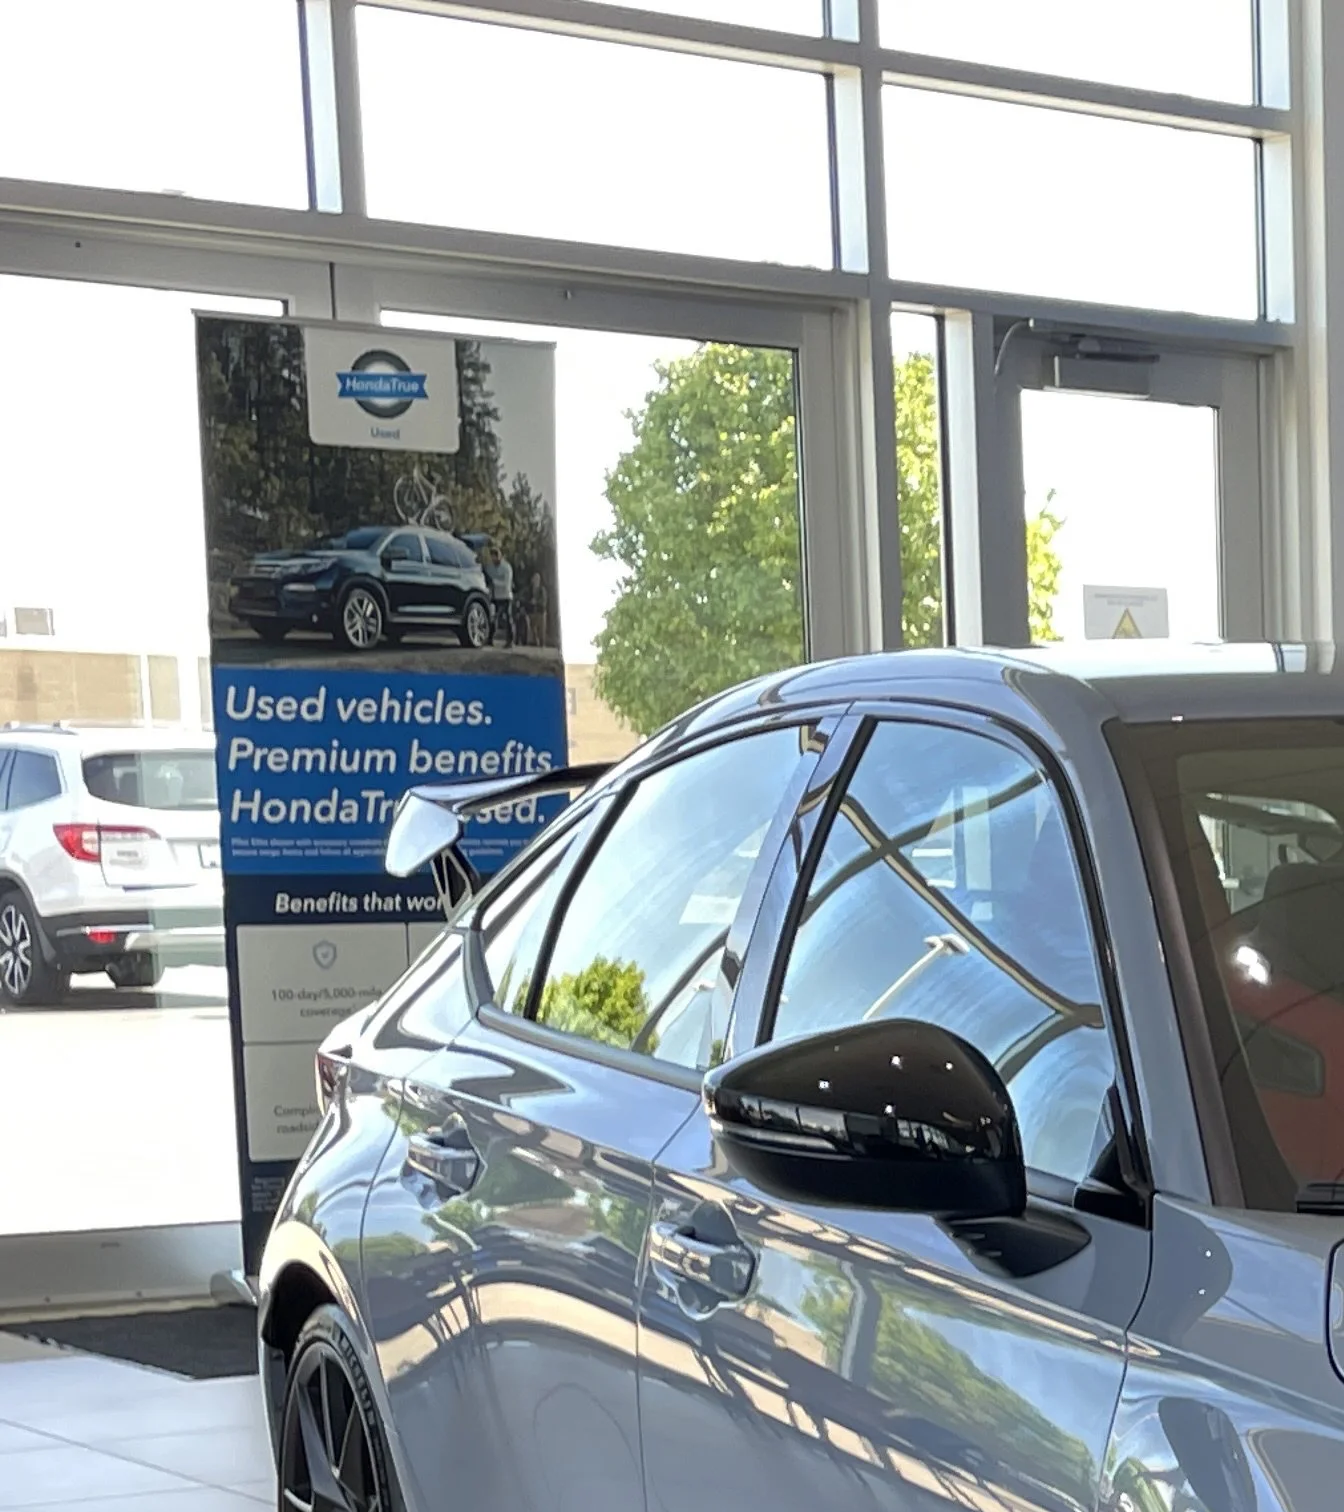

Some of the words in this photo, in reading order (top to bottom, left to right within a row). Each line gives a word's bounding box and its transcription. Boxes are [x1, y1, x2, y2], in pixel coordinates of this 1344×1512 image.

[345, 376, 420, 393] HondaTrue
[370, 427, 400, 439] Used
[225, 685, 326, 722] Used
[336, 687, 492, 726] vehicles.
[227, 737, 397, 774] Premium
[230, 788, 400, 825] HondaTr
[275, 891, 358, 913] Benefits
[363, 891, 401, 912] that
[341, 1337, 375, 1425] MICHELIN
